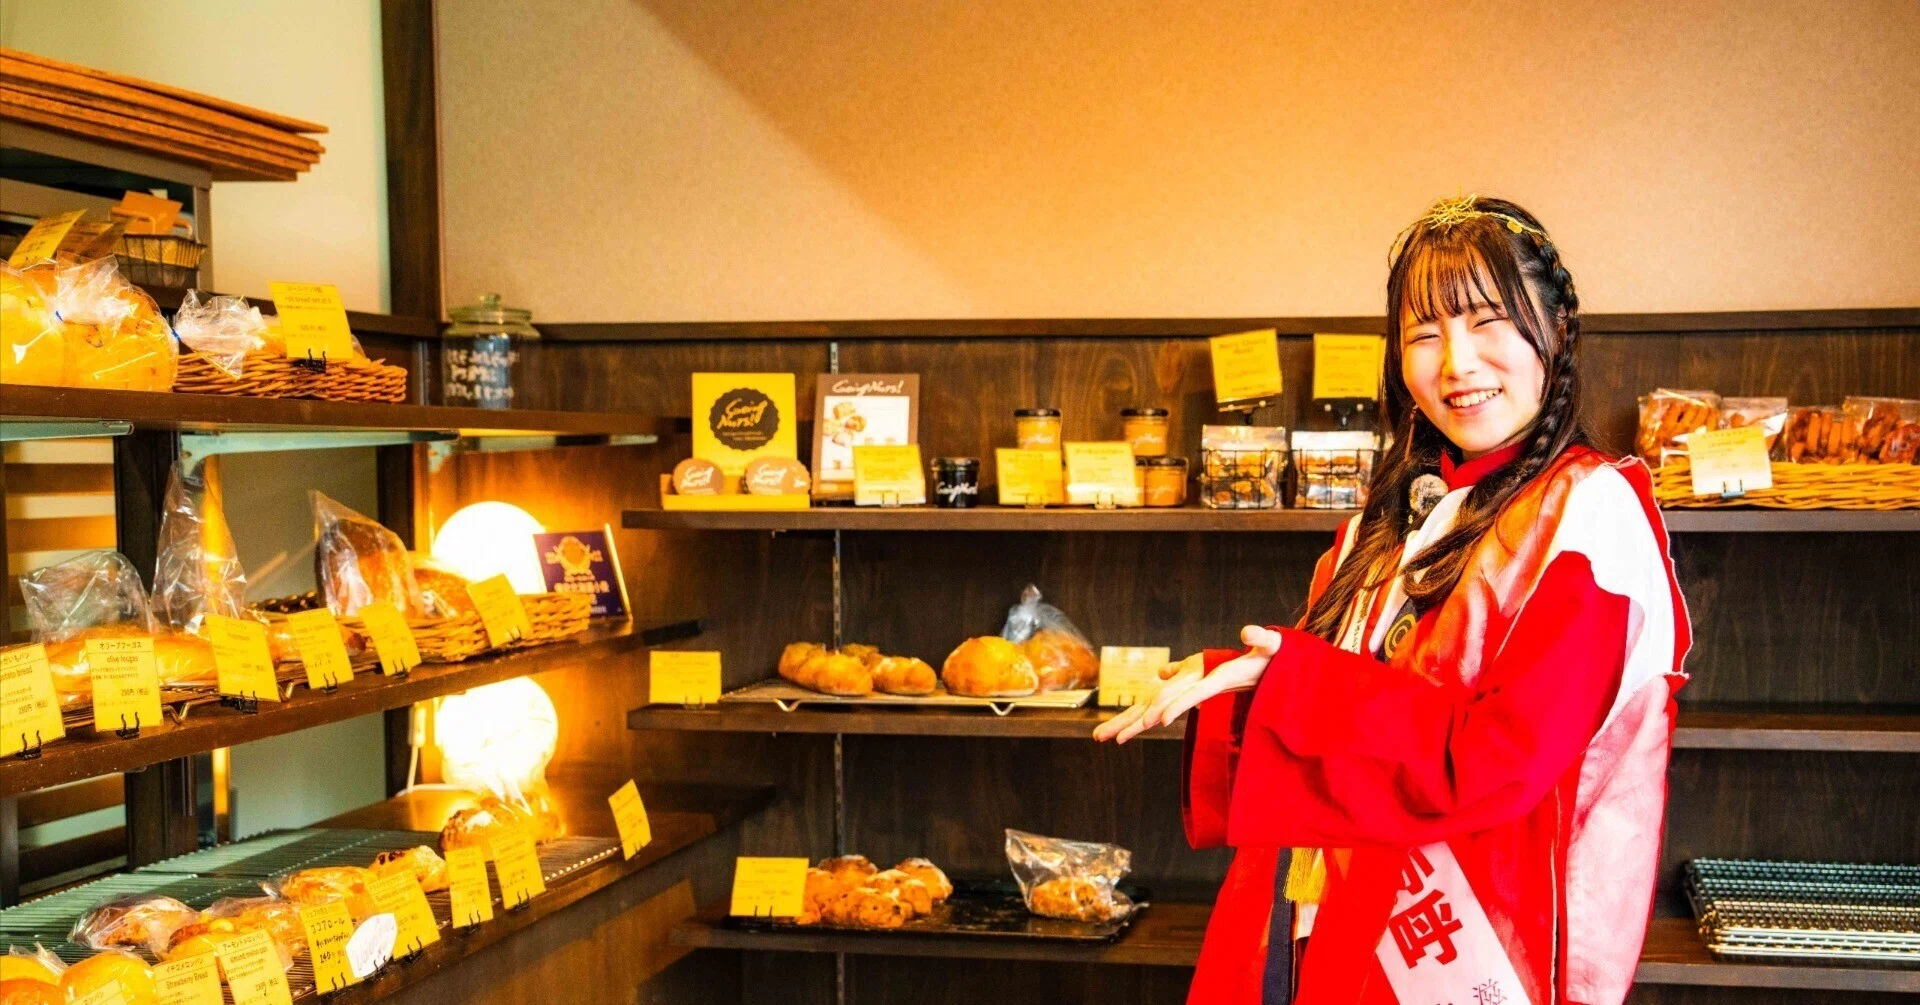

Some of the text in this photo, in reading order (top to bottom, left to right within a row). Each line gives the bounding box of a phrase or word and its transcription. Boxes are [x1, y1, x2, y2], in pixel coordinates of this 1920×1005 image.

[16, 666, 33, 676] bread
[166, 971, 209, 989] Strawberry Bread
